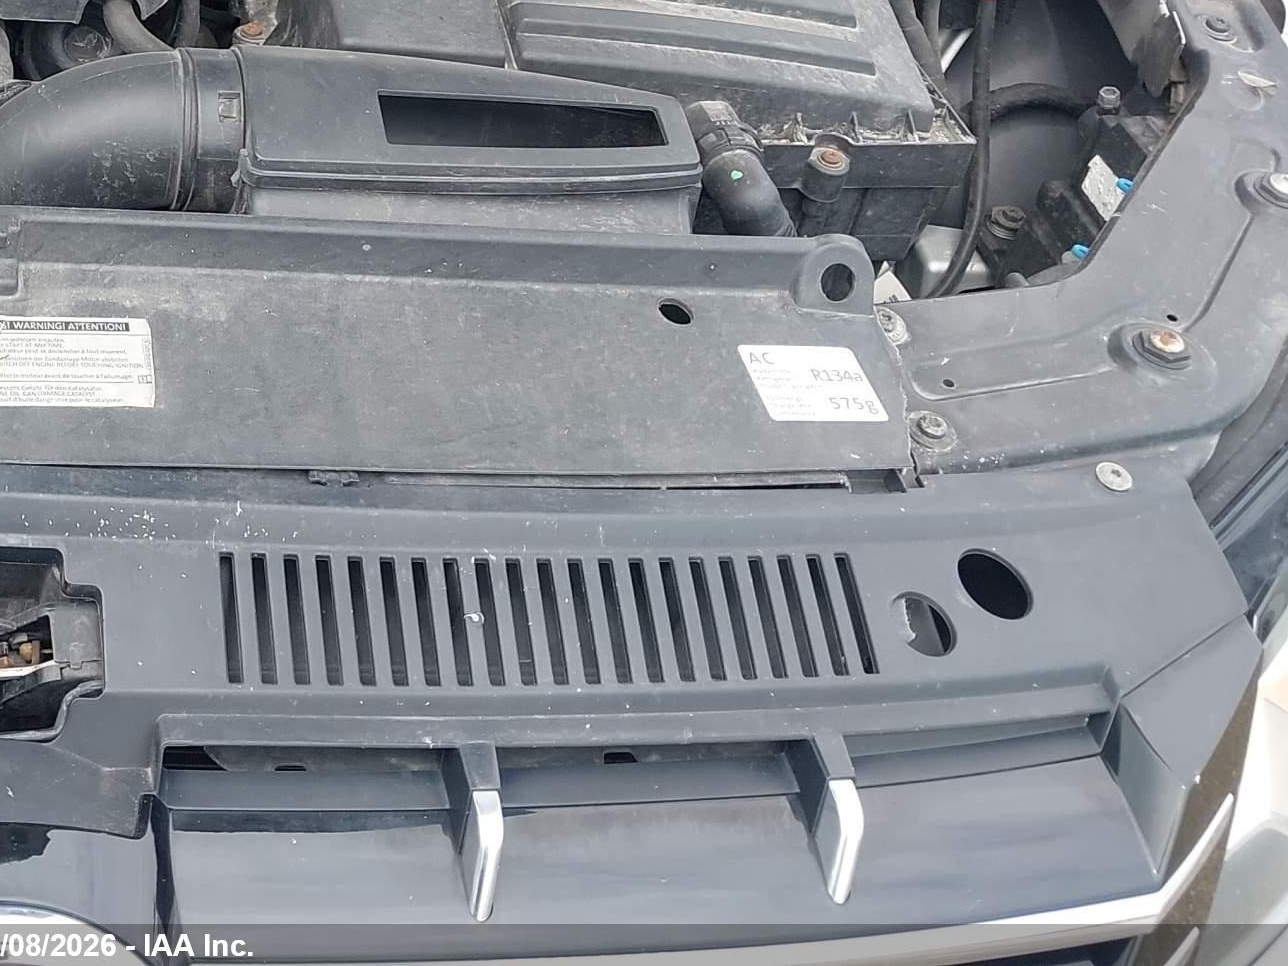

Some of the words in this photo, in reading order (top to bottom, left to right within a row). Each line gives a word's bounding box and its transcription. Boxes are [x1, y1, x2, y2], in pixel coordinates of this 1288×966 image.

[13, 321, 66, 330] WARNING!
[68, 322, 126, 331] ATTENTION!
[749, 351, 775, 365] AC
[809, 368, 864, 383] R134a
[828, 396, 880, 416] 575g
